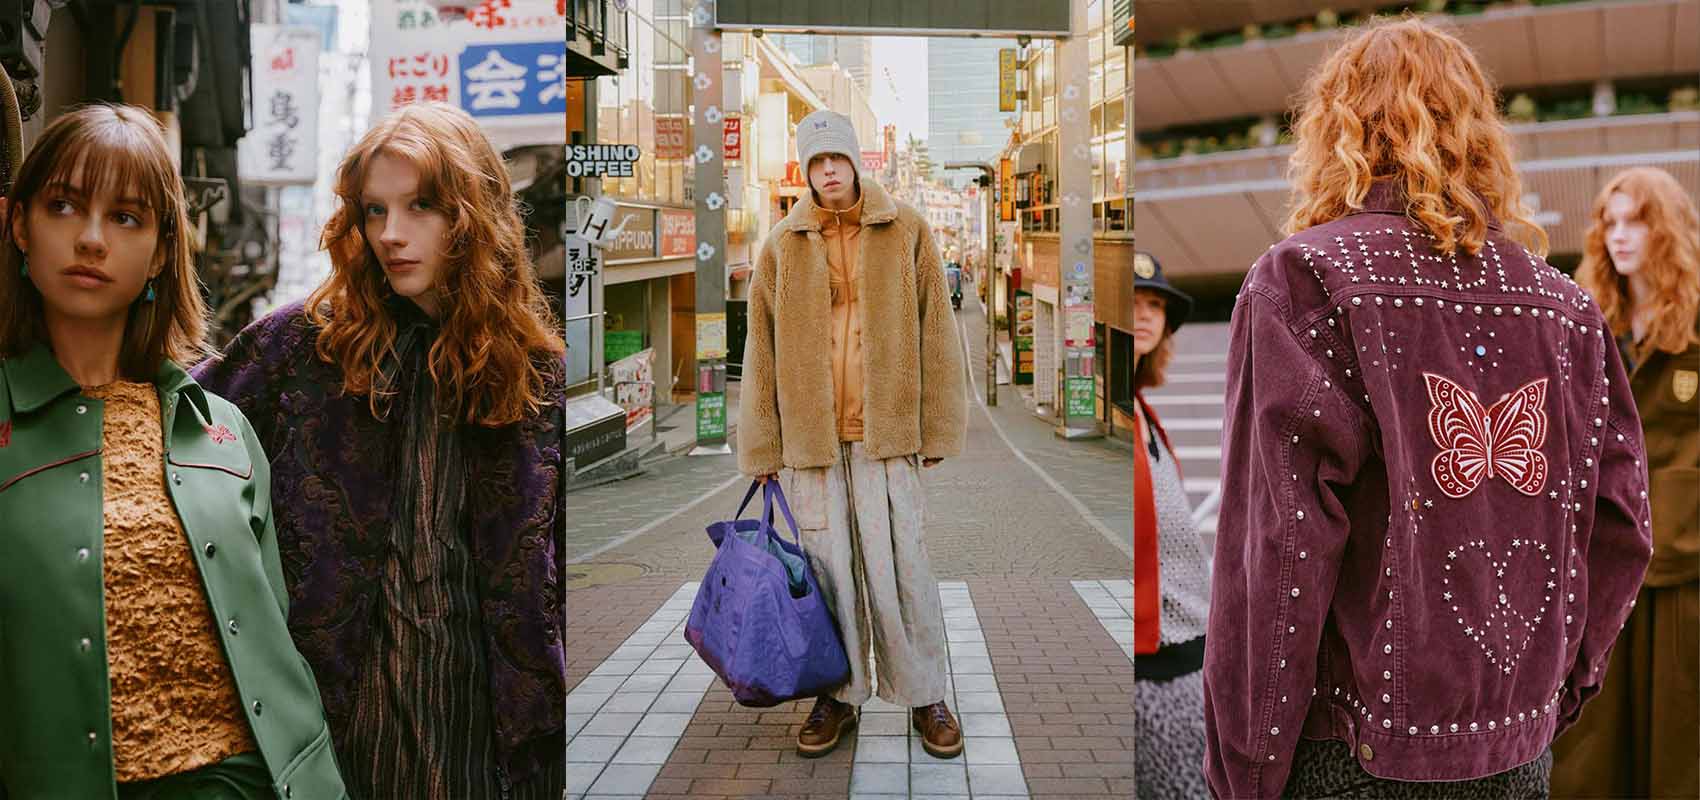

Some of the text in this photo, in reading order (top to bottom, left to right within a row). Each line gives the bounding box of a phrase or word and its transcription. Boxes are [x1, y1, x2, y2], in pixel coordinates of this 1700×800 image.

[388, 51, 449, 79] にごり
[567, 162, 632, 176] OFFEE
[582, 213, 608, 240] H
